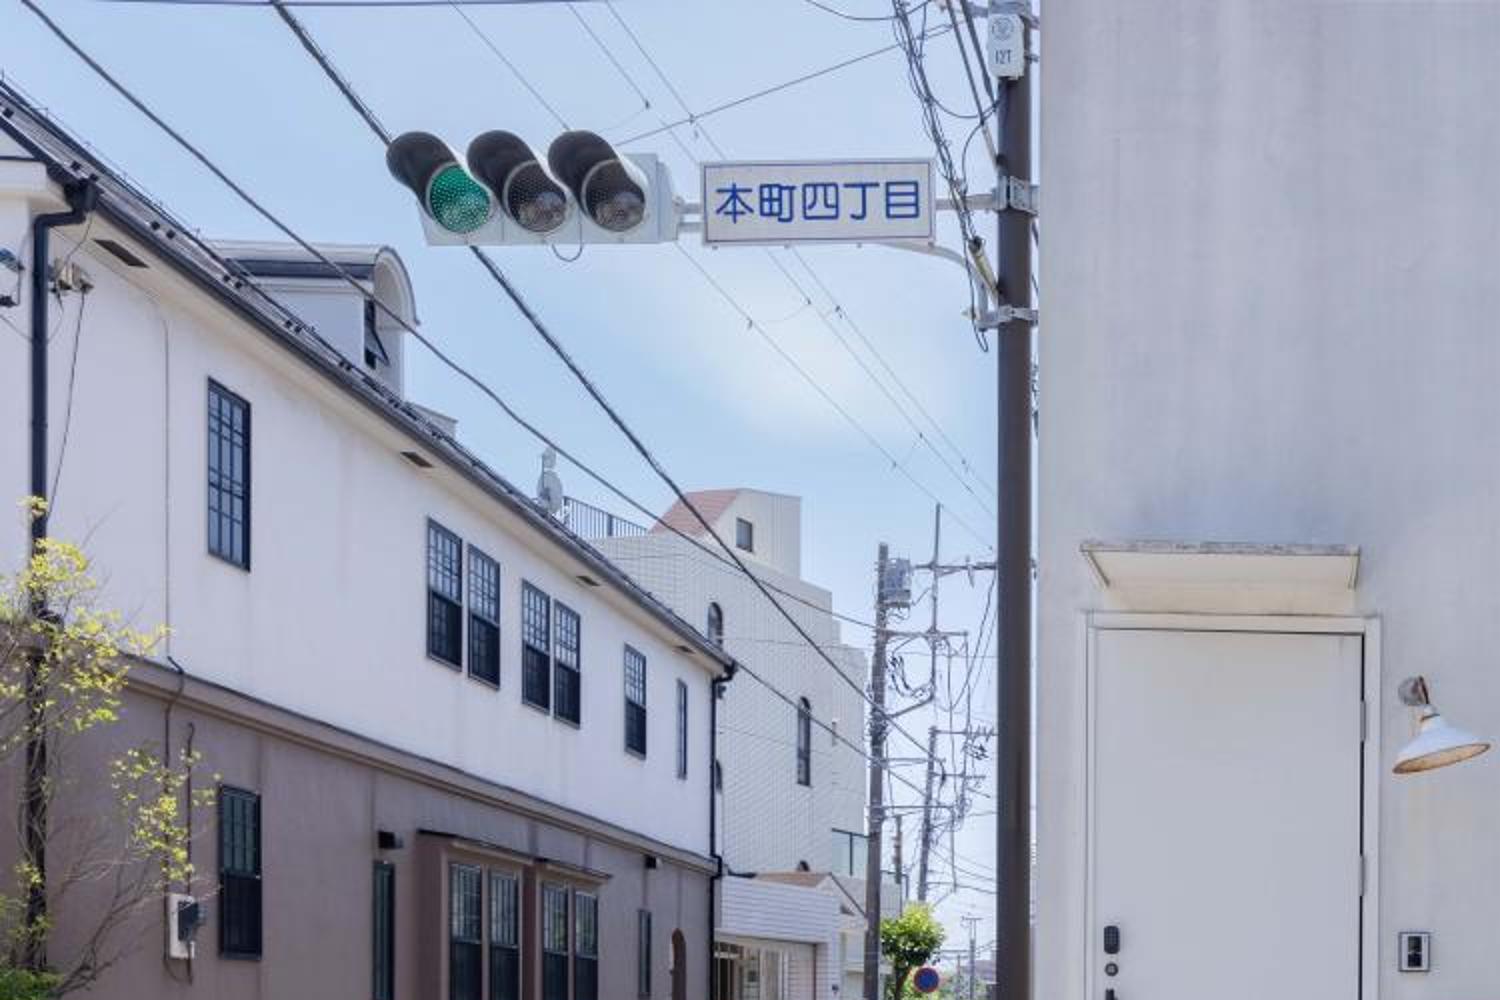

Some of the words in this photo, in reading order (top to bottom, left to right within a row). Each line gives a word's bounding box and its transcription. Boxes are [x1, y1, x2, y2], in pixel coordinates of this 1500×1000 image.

[716, 180, 920, 224] 本町四丁目
